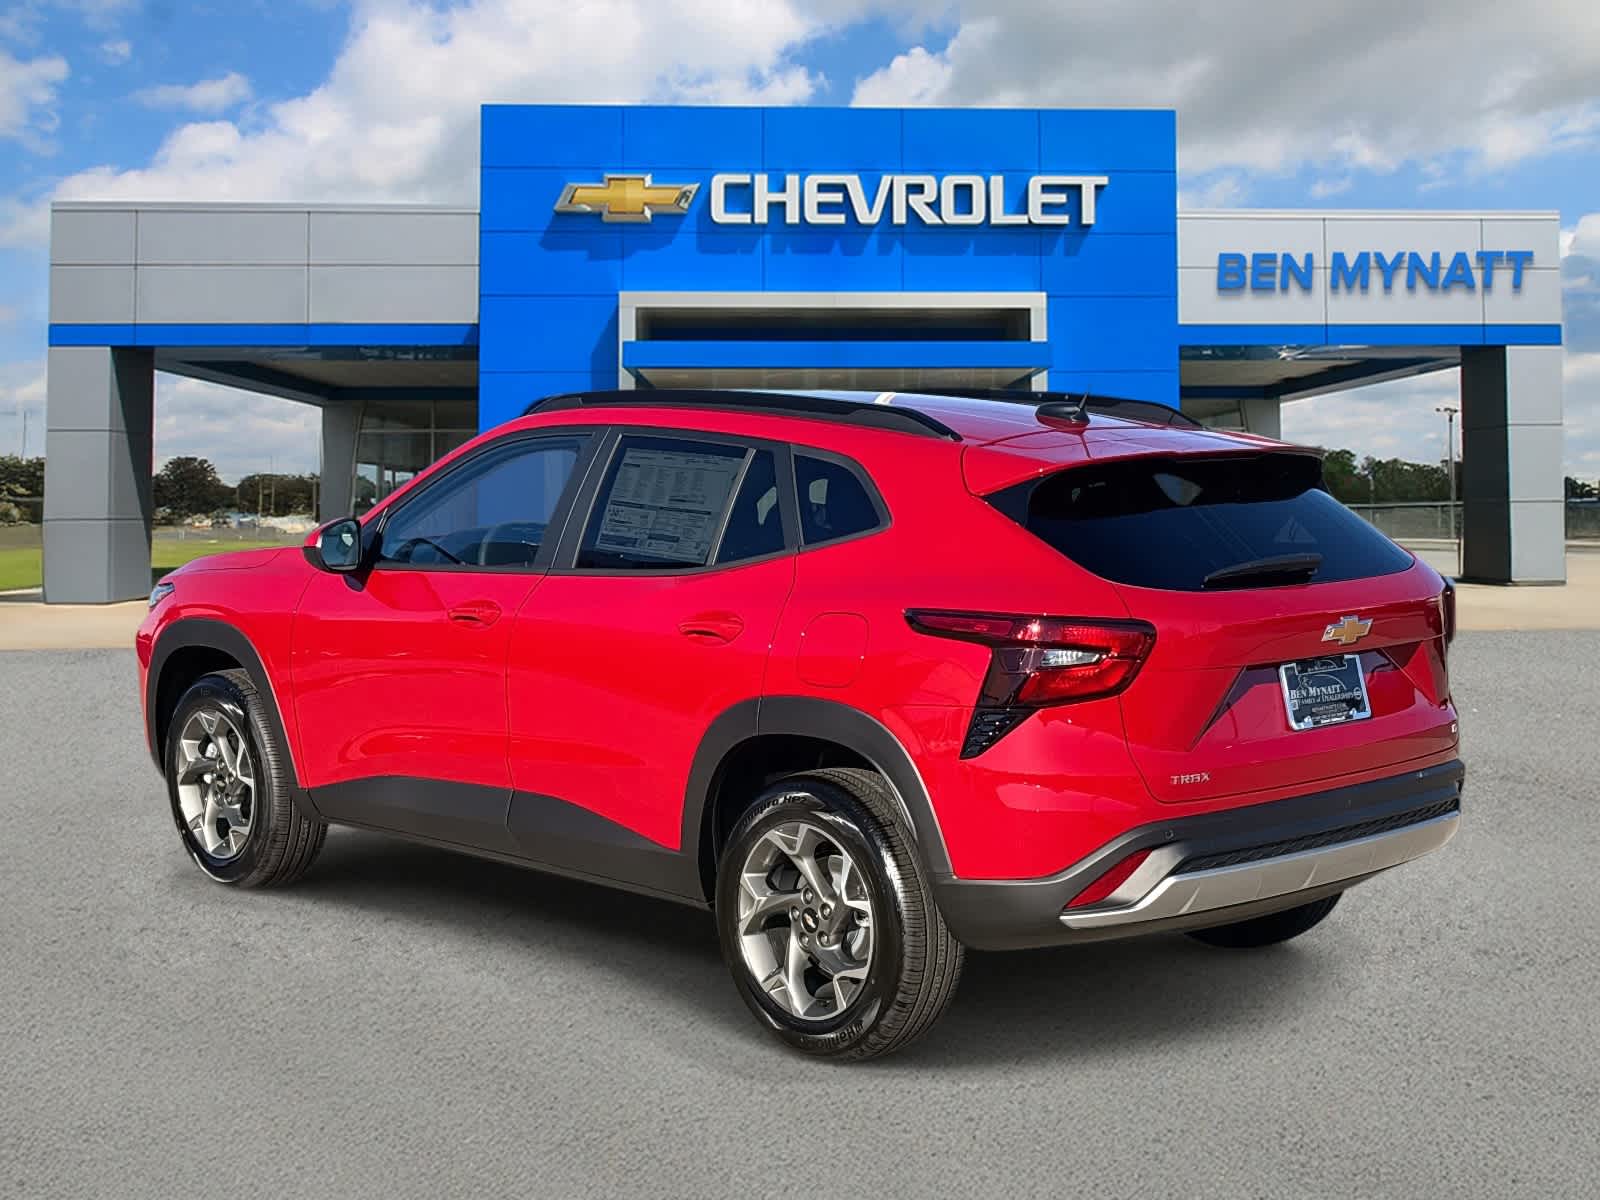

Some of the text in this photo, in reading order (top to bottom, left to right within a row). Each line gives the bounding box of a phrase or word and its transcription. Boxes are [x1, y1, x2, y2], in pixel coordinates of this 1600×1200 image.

[710, 174, 1109, 225] CHEVROLET
[1217, 250, 1534, 290] BEN MYNATT
[1170, 772, 1210, 785] TRAX
